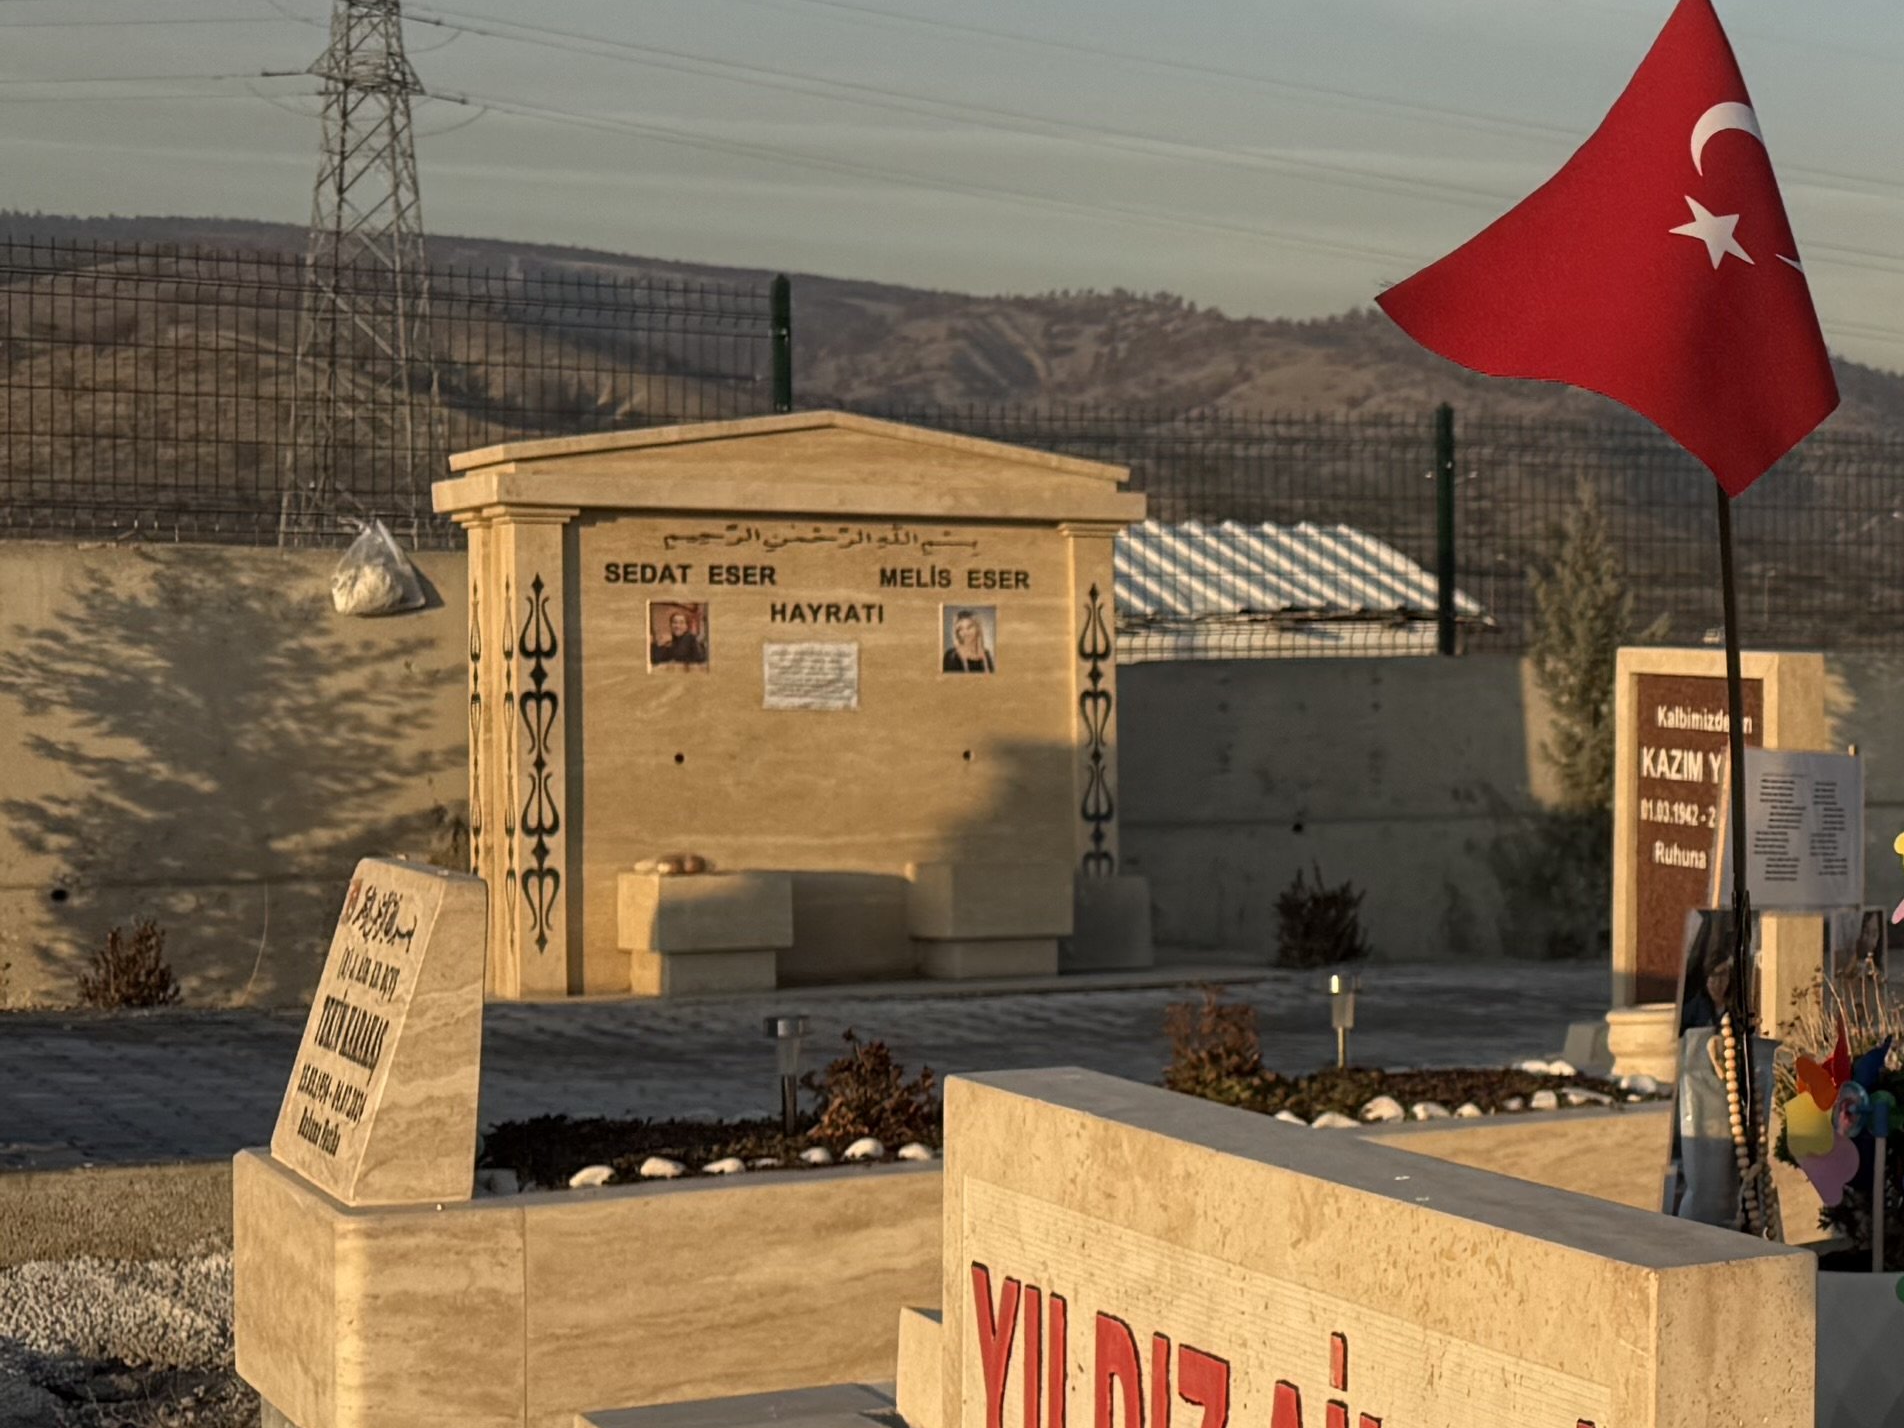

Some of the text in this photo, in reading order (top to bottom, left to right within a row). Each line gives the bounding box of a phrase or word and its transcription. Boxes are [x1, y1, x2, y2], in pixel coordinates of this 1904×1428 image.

[604, 562, 777, 586] SEDAT ESER
[879, 564, 1030, 590] MELİS ESER
[770, 602, 884, 624] HAYRATI
[1658, 705, 1753, 734] Kalbimizden
[1641, 745, 1703, 783] KAZIM
[1655, 840, 1708, 870] Ruhuna
